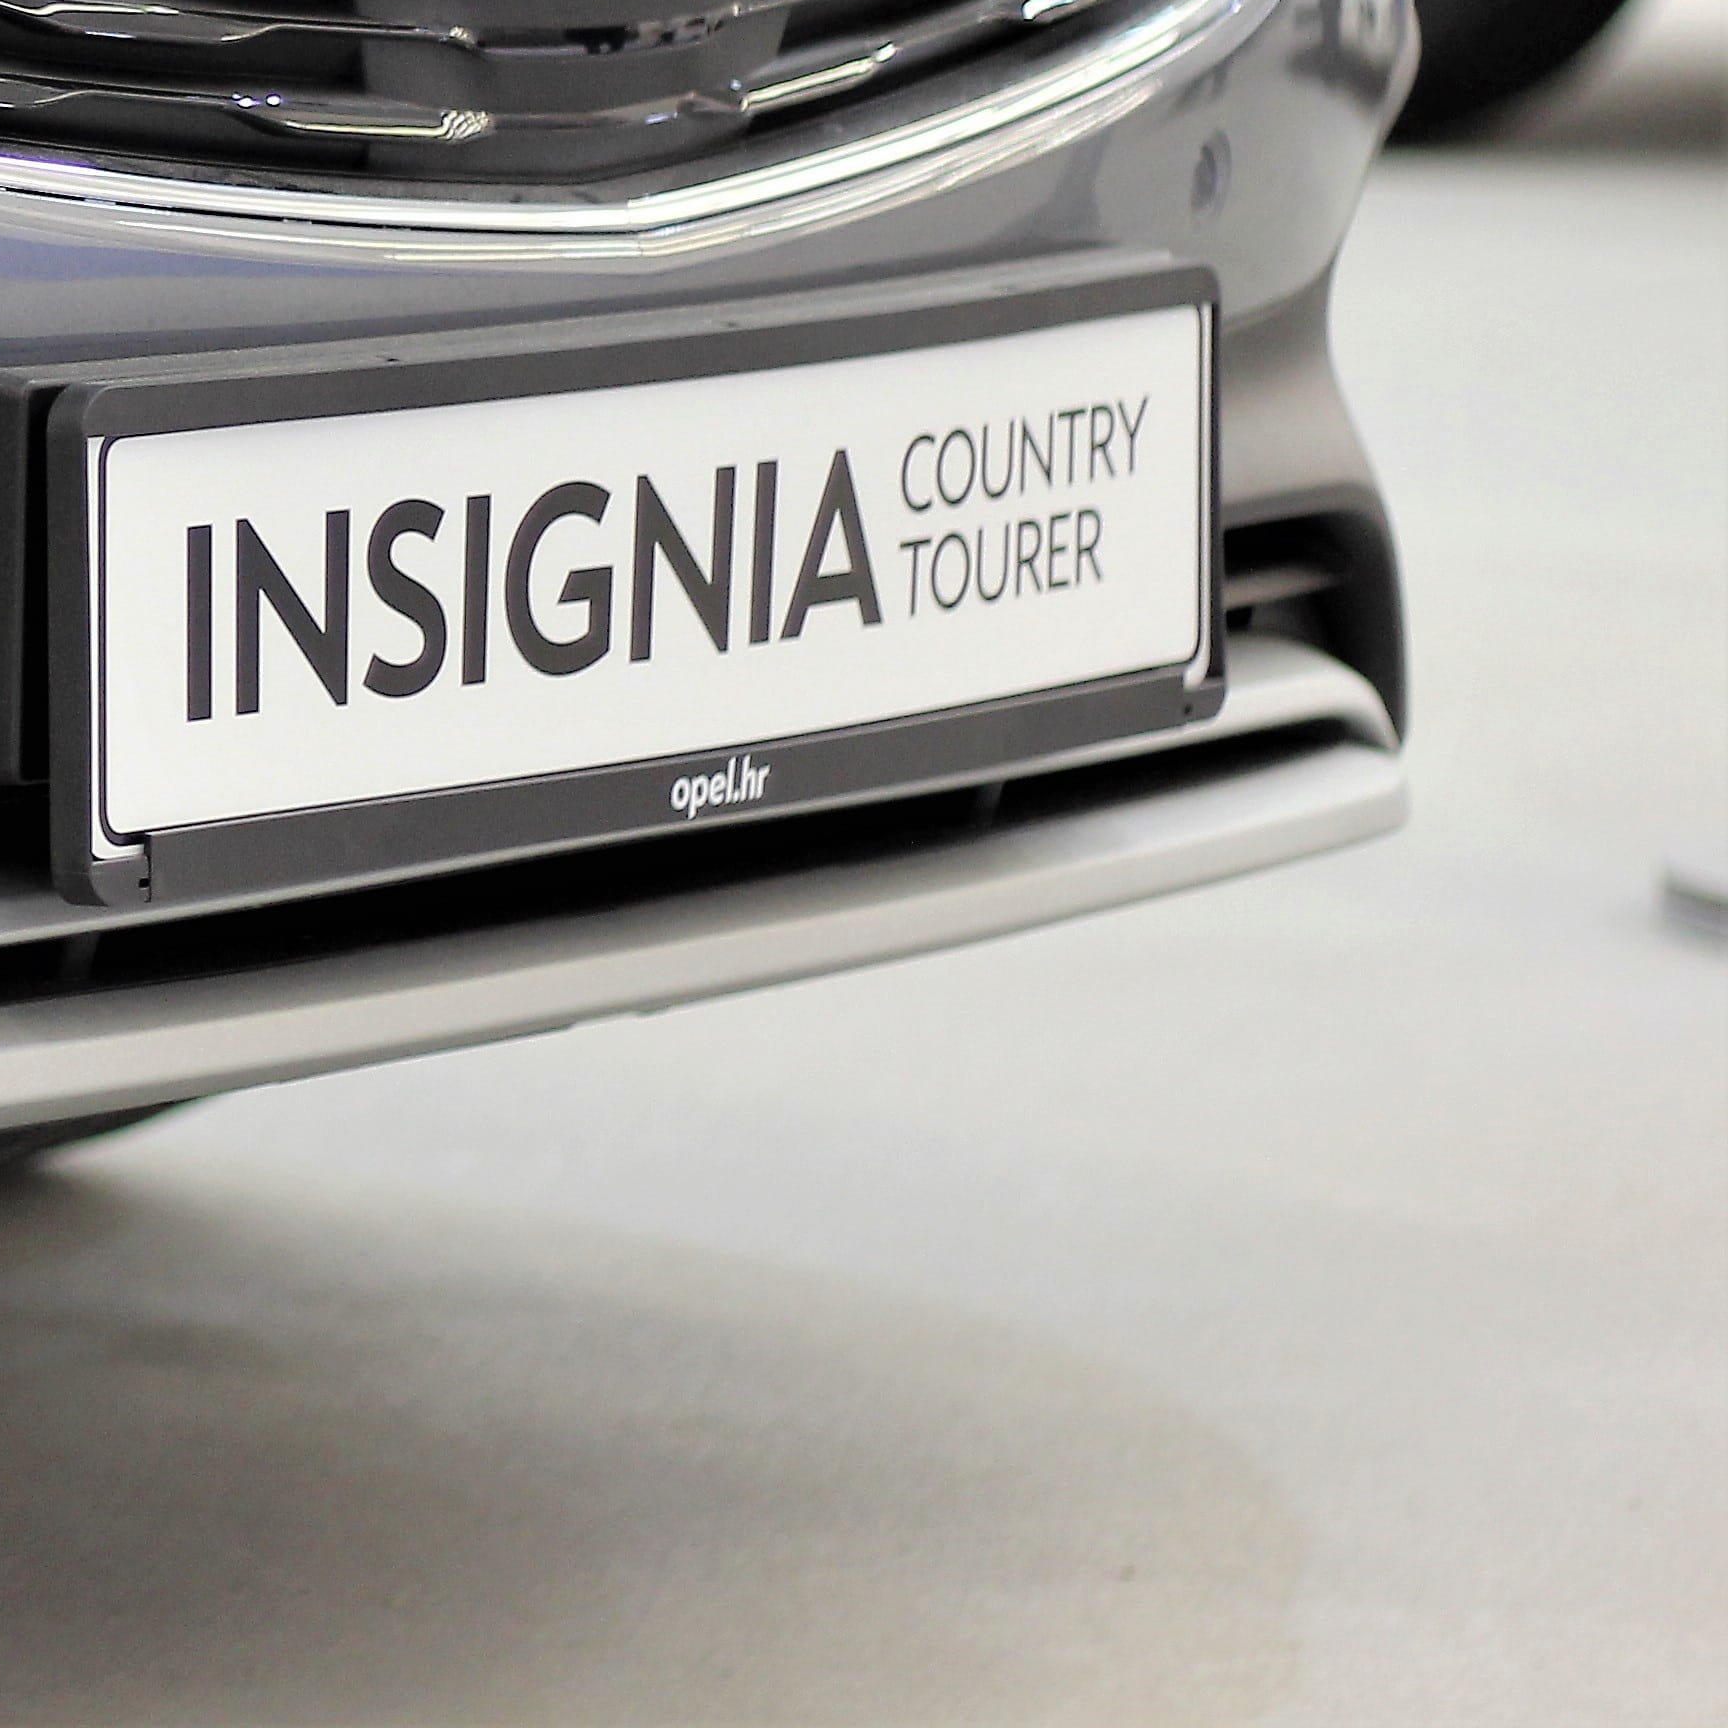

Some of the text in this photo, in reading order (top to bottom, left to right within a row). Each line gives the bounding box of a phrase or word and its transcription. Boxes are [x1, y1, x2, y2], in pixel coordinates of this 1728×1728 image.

[901, 396, 1148, 512] COUNTRY
[186, 449, 882, 722] INSIGNIA
[900, 508, 1102, 617] TOURER
[670, 754, 771, 820] opel.hr
